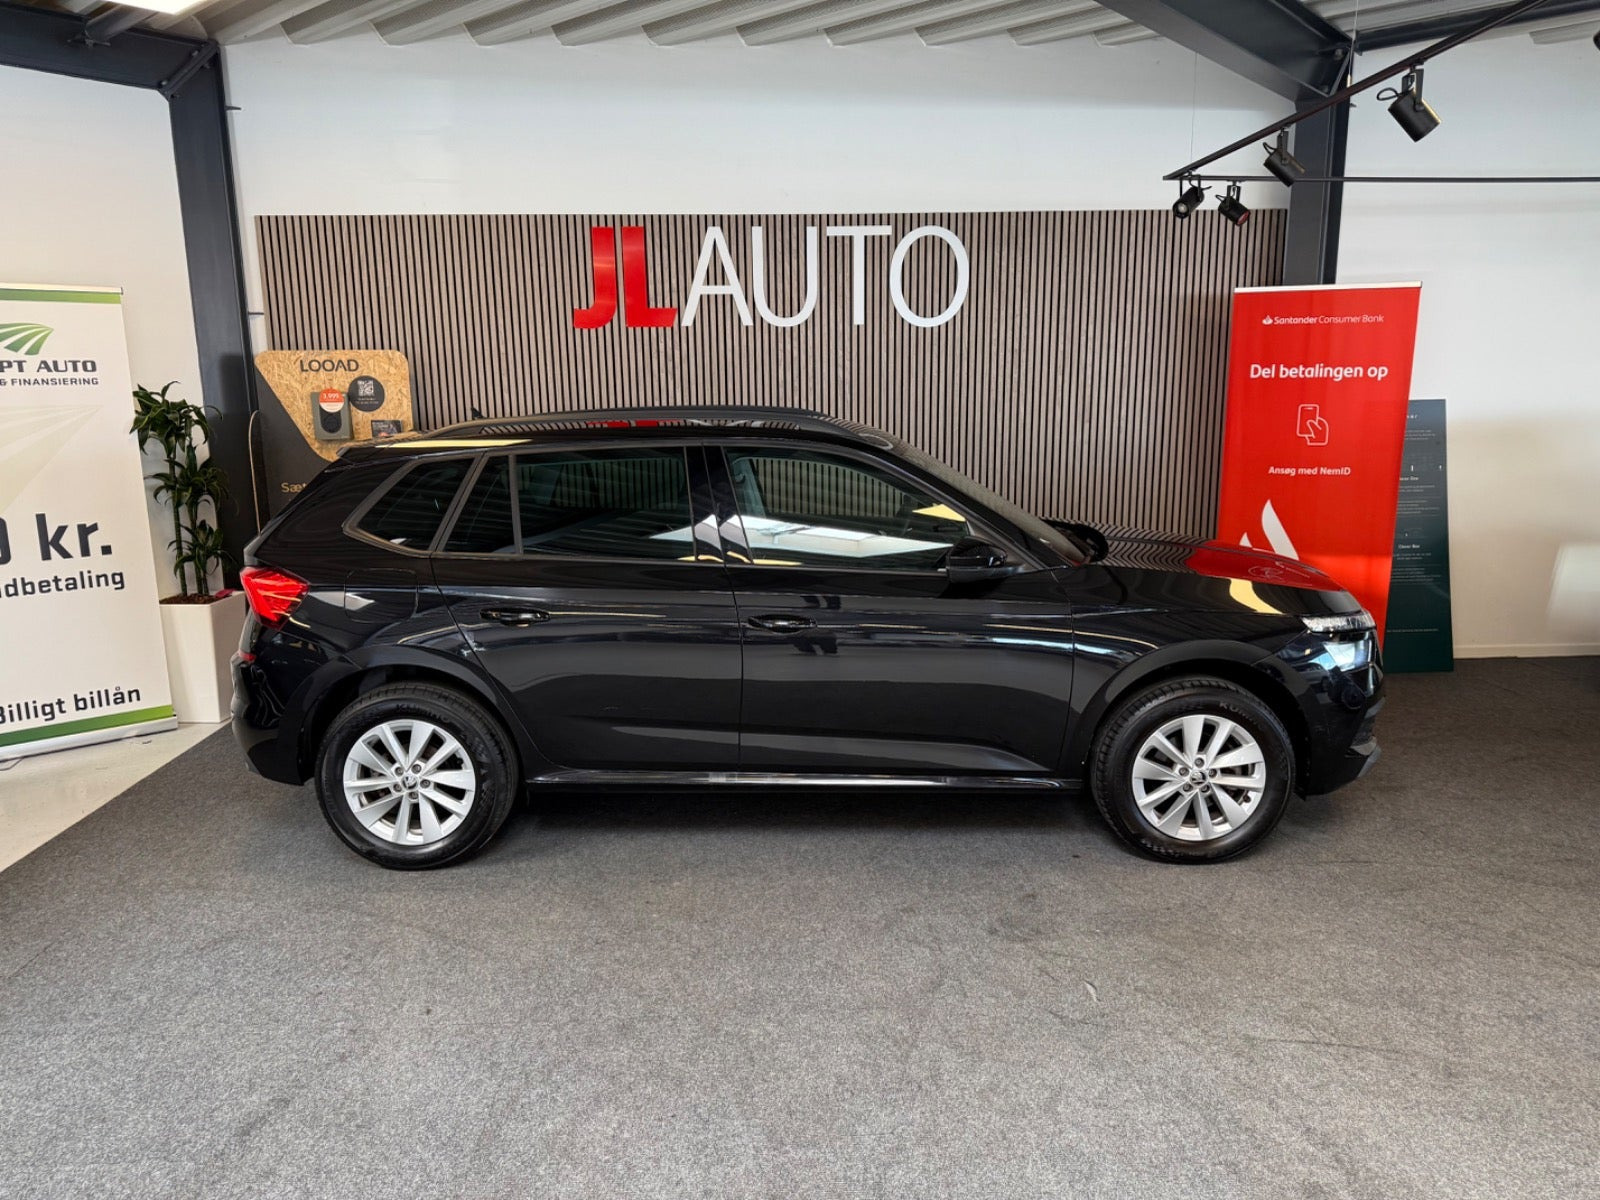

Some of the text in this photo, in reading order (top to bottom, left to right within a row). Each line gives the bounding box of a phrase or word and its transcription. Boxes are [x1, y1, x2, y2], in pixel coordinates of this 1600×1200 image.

[681, 225, 970, 328] AUTO
[1362, 314, 1384, 323] Bank
[37, 360, 97, 373] AUTO
[1250, 363, 1389, 381] Del betalingen op
[11, 377, 99, 387] FINANSIERING
[1268, 466, 1351, 477] Ansøg med NemID
[281, 482, 307, 493] Sæ
[36, 513, 112, 562] kr.
[0, 569, 125, 599] dbetaling
[74, 686, 141, 712] billån
